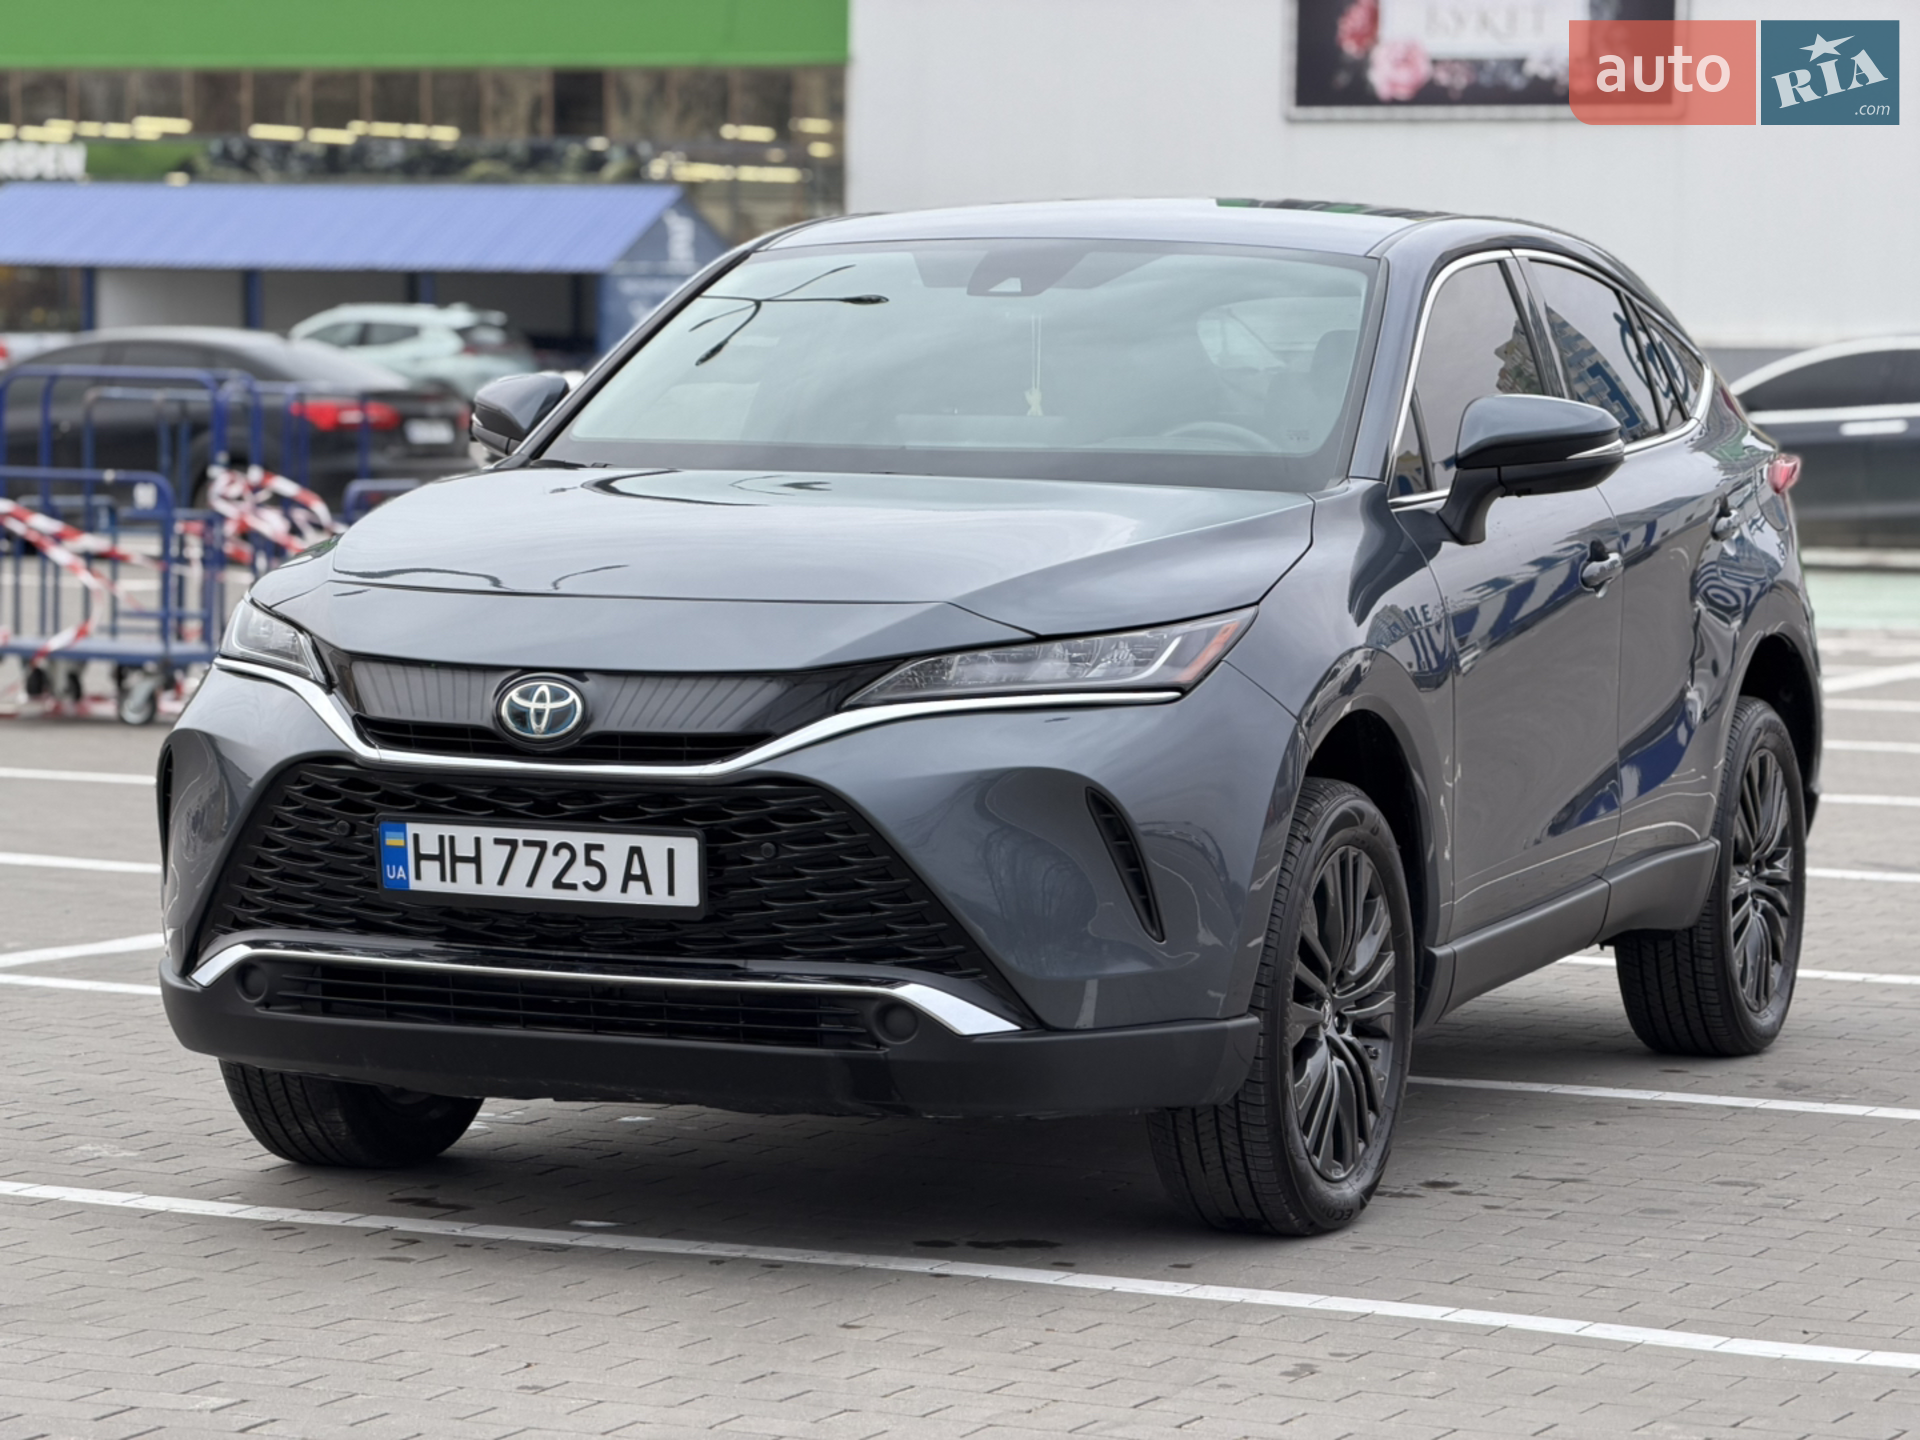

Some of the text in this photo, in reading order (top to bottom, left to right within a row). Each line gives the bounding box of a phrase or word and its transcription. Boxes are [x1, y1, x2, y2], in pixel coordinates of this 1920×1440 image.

[386, 864, 407, 881] UA
[412, 832, 676, 897] HH 7725 AI
